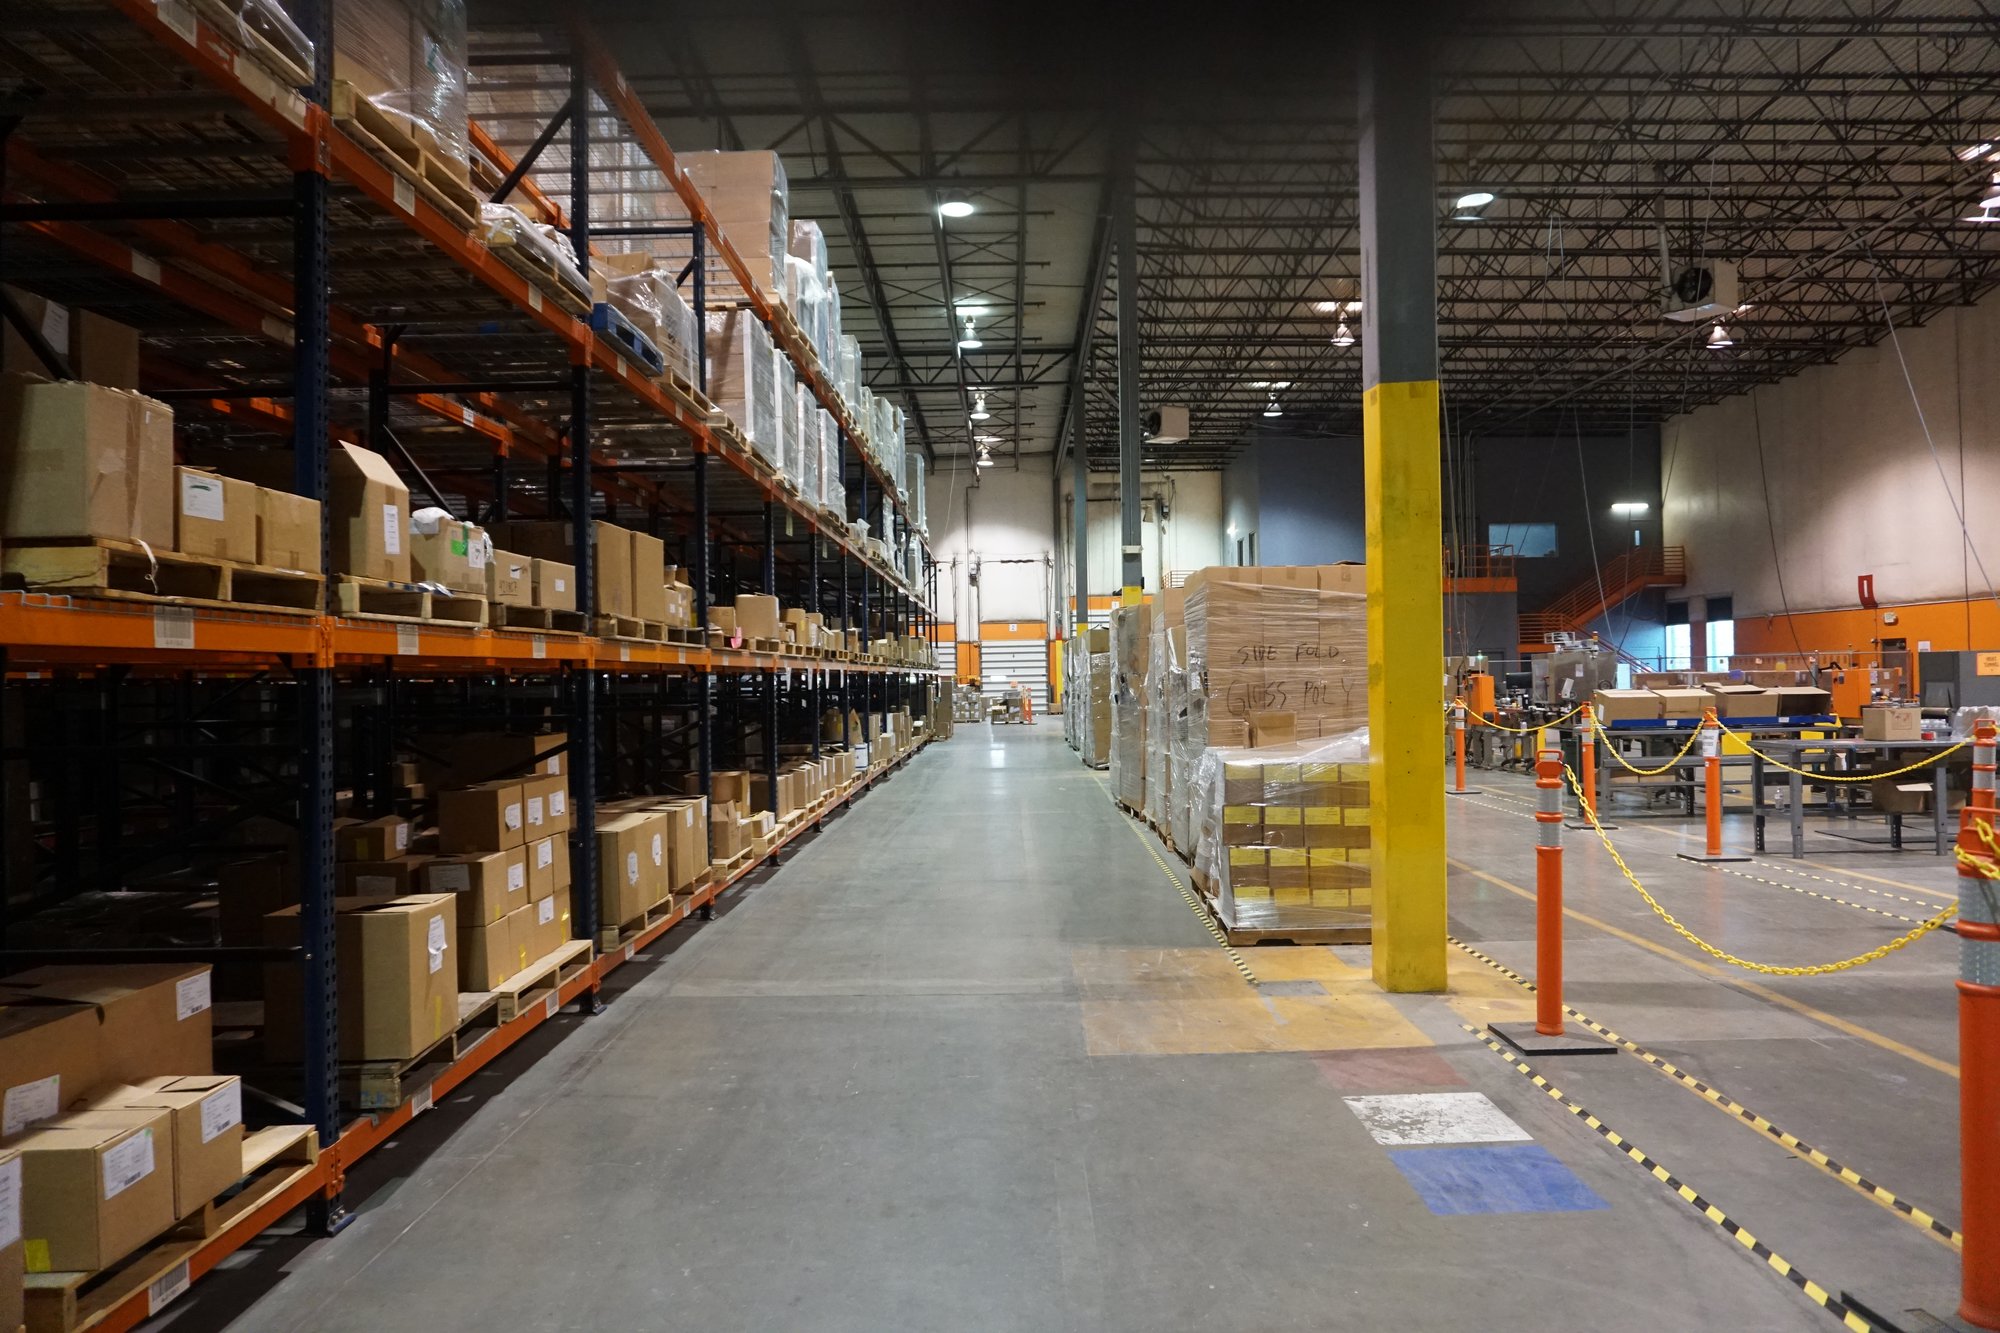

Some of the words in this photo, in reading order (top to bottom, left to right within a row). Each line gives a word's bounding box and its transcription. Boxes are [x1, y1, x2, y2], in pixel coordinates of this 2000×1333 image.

[1237, 645, 1278, 664] SIDE
[1296, 643, 1339, 662] FOLD
[1303, 678, 1355, 712] POLY
